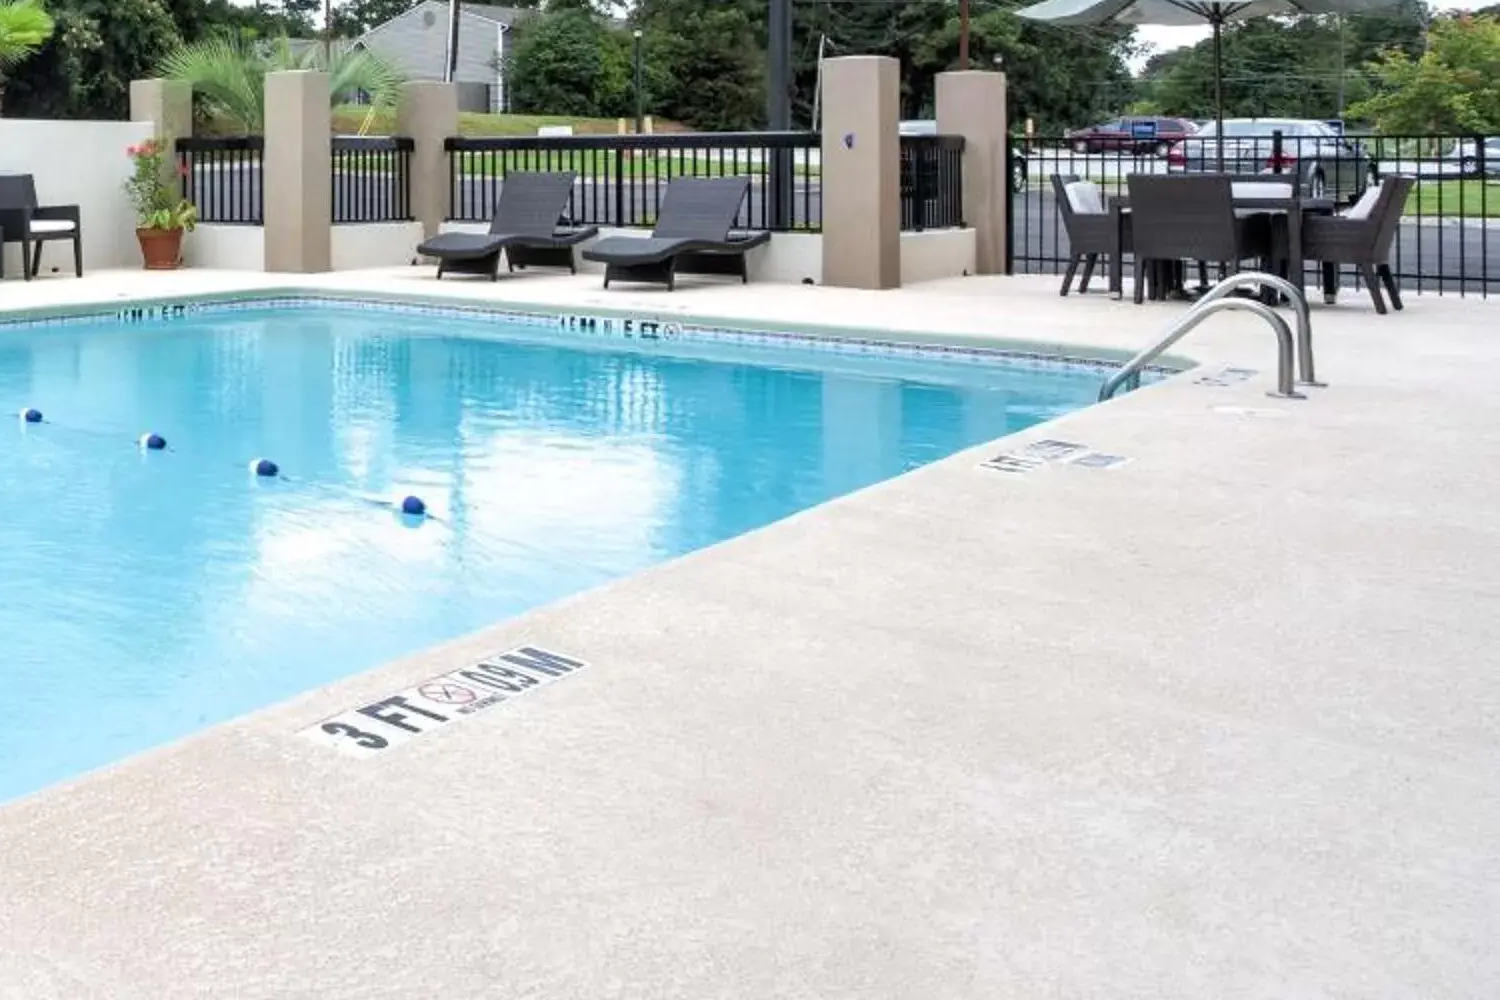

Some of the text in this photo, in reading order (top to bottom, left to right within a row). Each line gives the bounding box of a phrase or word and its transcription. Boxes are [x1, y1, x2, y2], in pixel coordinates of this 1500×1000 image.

[321, 721, 389, 749] 3
[356, 695, 450, 733] FT
[499, 647, 585, 677] M
